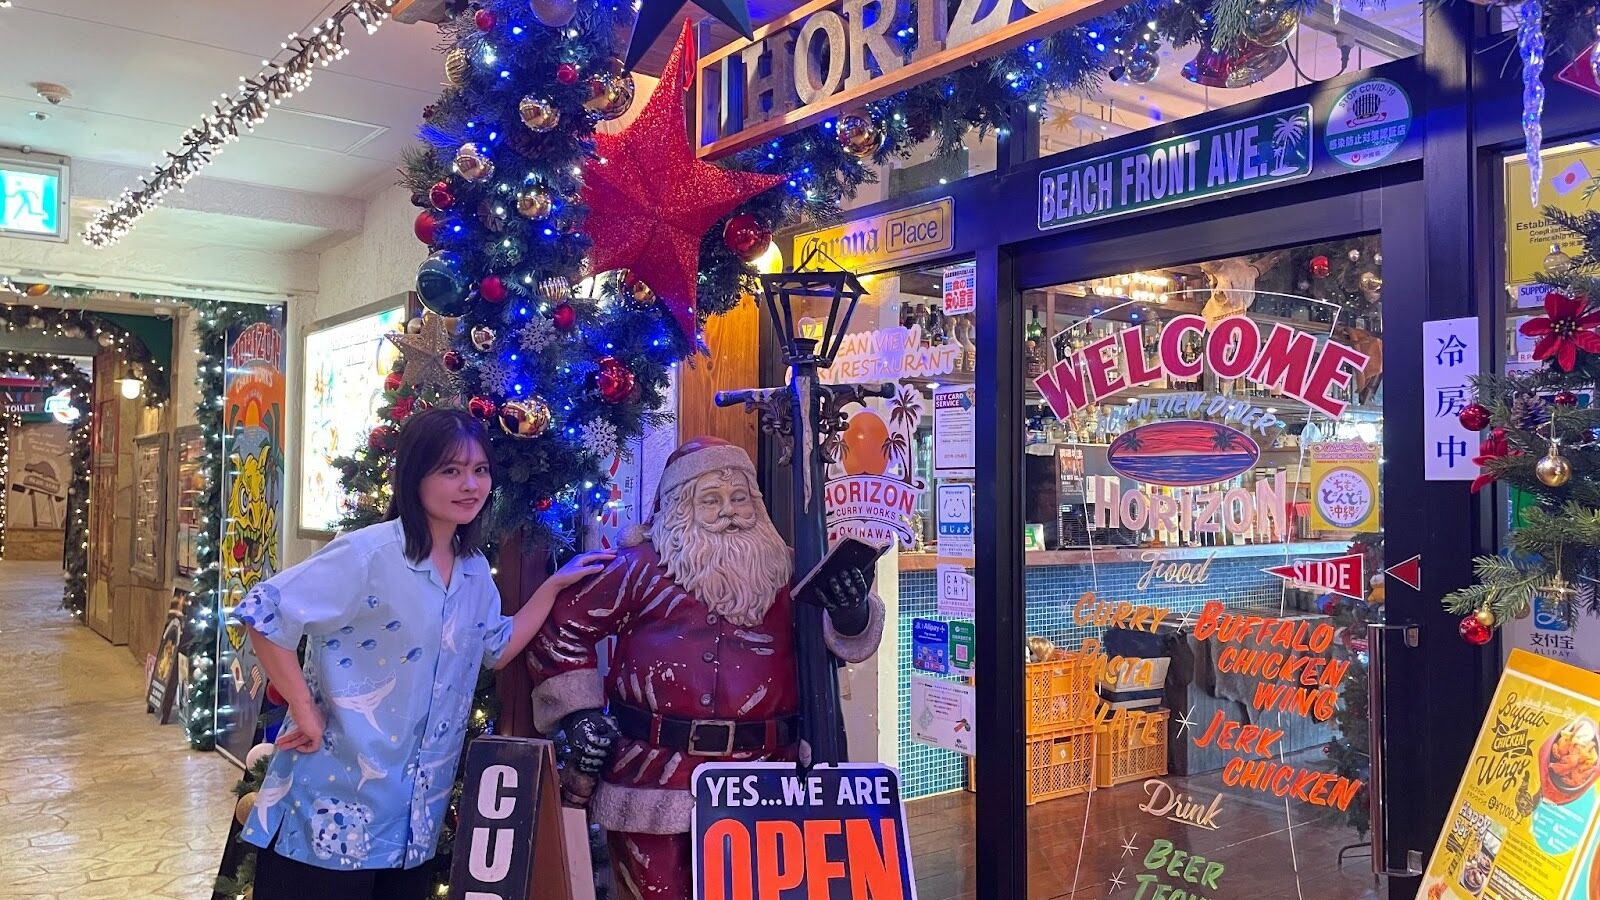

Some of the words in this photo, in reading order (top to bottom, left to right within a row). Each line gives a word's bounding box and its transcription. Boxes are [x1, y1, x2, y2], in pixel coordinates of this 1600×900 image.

[742, 0, 1062, 129] HORIZ
[1339, 90, 1357, 108] STOP
[1359, 83, 1396, 97] COVID-19
[1042, 161, 1112, 223] BEACH
[1120, 141, 1200, 206] FRONT
[1207, 125, 1267, 188] AVE.
[801, 228, 879, 272] Corona
[890, 219, 938, 247] Place
[874, 333, 918, 352] VIEW
[841, 350, 955, 379] RESTAURANT
[1033, 314, 1370, 421] WELCOME
[5, 404, 36, 413] TOILET
[936, 400, 960, 408] SERVICE
[948, 392, 963, 400] CARD
[1156, 391, 1207, 415] VIEW
[1206, 394, 1277, 437] DINER
[1435, 333, 1467, 469] 冷房中
[836, 506, 862, 517] CURRY
[866, 507, 896, 520] WORKS
[1094, 470, 1288, 536] HORIZON
[839, 526, 892, 540] OKINAWA
[1137, 551, 1217, 591] Food
[1293, 561, 1351, 591] SLIDE
[1073, 591, 1169, 634] CURRY
[1193, 600, 1335, 654] BUFFALO
[1530, 632, 1574, 650] 支付宝
[1534, 648, 1571, 657] ALIPAY
[1077, 637, 1154, 688] PASTA
[1217, 645, 1350, 689] CHICKEN
[1252, 681, 1339, 722] WING
[1498, 691, 1549, 731] Buffalo
[1193, 709, 1286, 760] JERK
[1494, 734, 1526, 749] CHICKEN
[837, 775, 891, 806] ARE
[1222, 756, 1363, 813] CHICKEN
[1475, 755, 1531, 793] Wings
[1138, 778, 1224, 830] Drink
[465, 764, 519, 900] CU
[703, 818, 904, 900] OPEN
[1143, 838, 1225, 891] BEER
